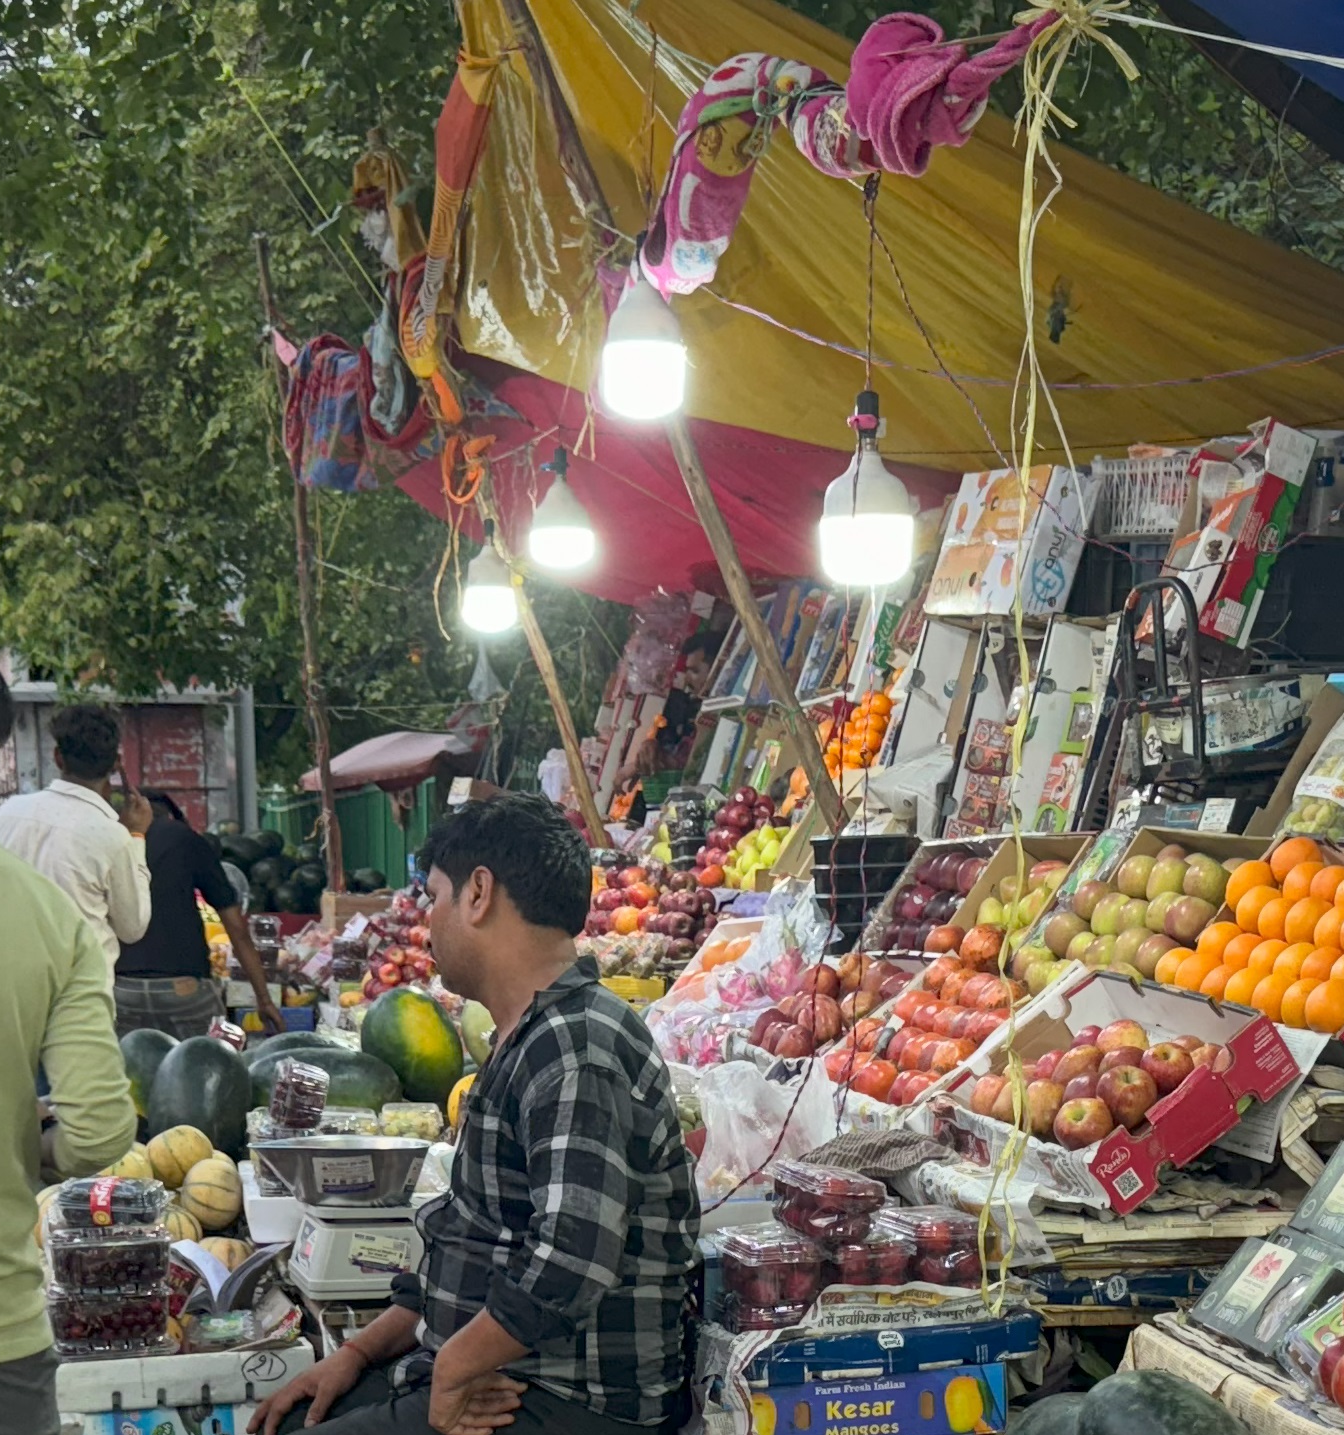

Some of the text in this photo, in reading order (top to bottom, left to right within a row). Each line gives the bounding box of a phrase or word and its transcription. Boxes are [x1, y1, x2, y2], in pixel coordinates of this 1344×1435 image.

[1044, 526, 1068, 570] anuj
[815, 1380, 906, 1397] Farm Fresh Indian
[825, 1400, 896, 1421] Kesar
